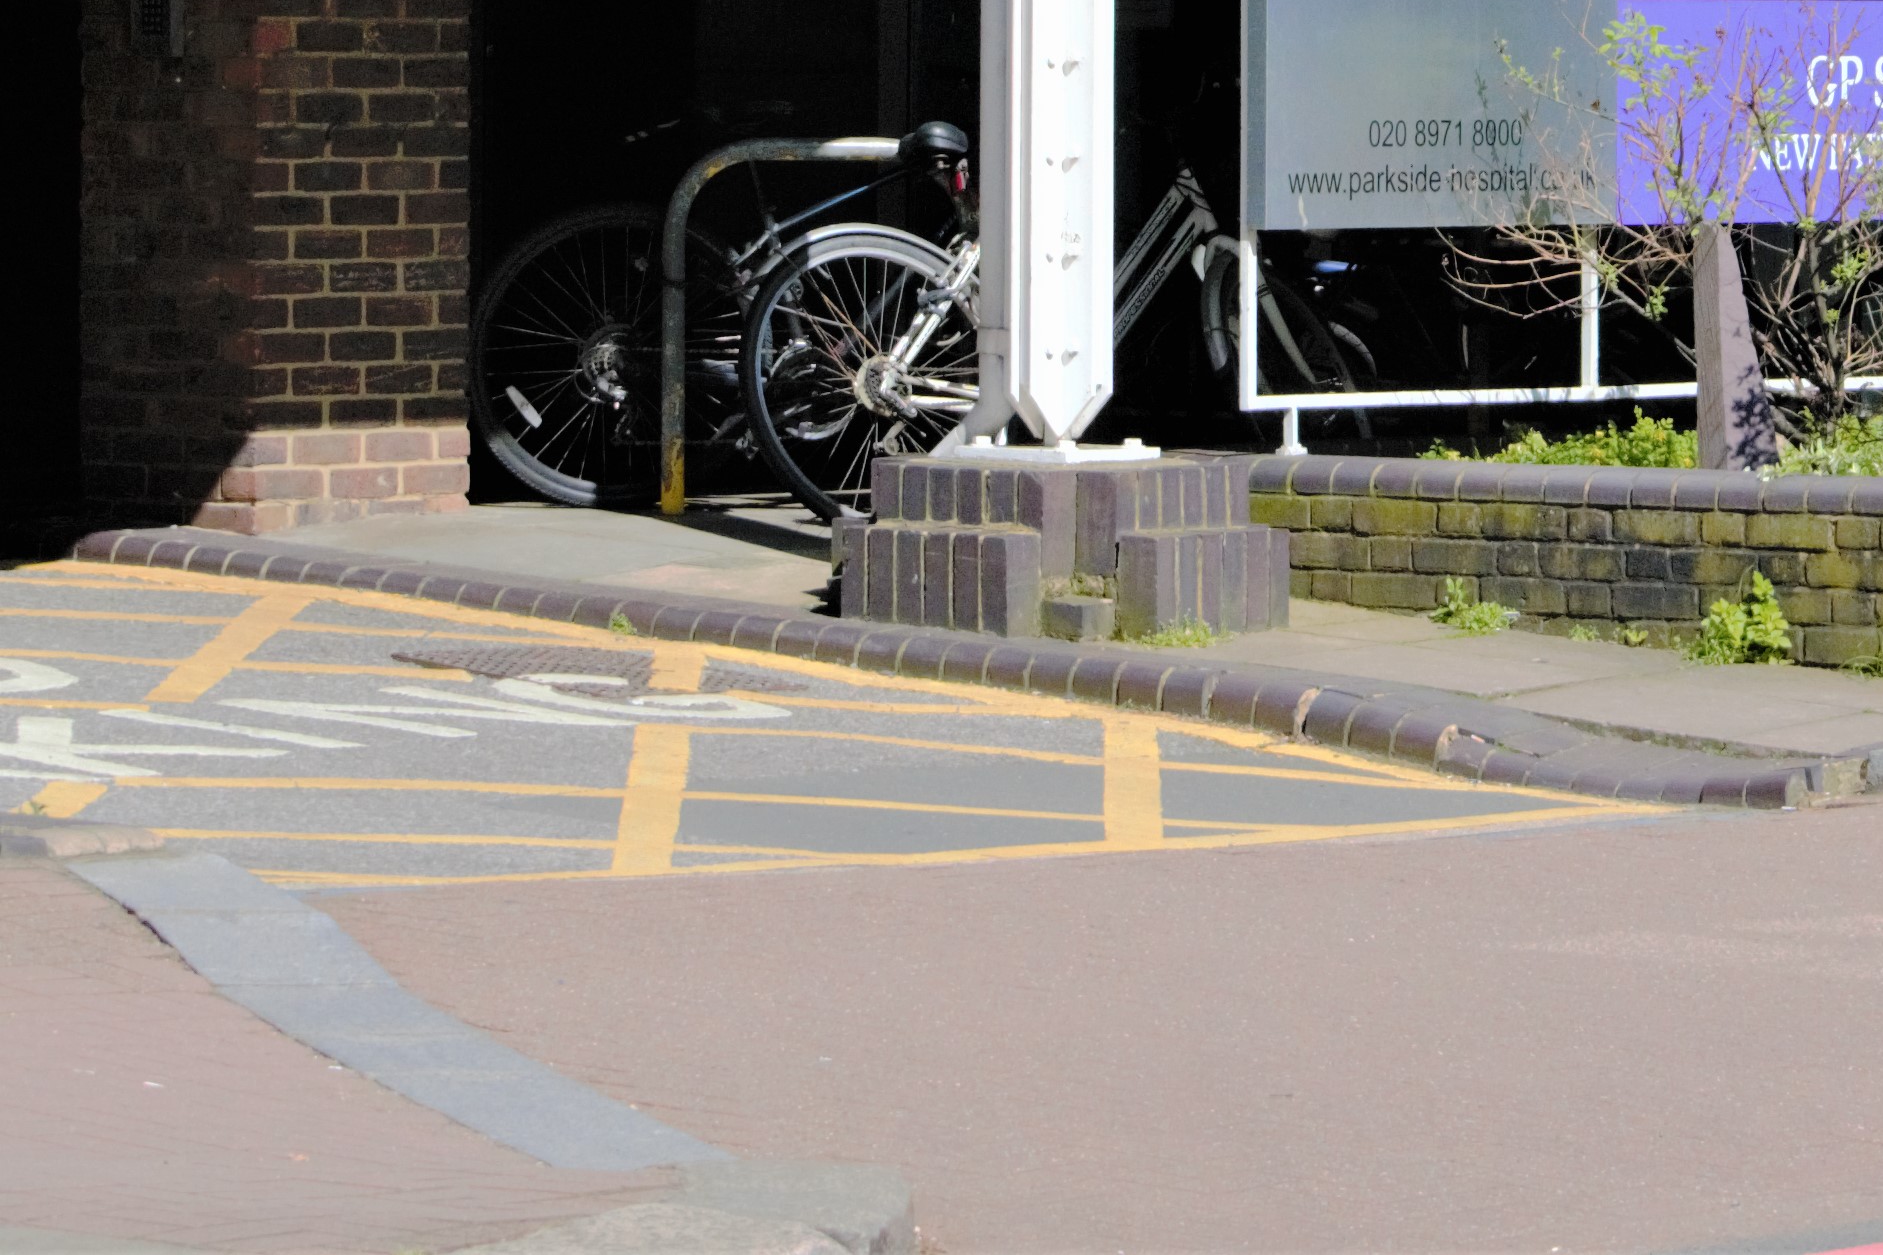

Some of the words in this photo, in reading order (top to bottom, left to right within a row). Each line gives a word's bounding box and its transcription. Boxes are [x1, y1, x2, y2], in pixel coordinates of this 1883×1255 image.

[1807, 55, 1863, 108] GP
[1368, 119, 1407, 147] 020
[1414, 119, 1463, 147] 8971
[1472, 119, 1523, 147] 8000
